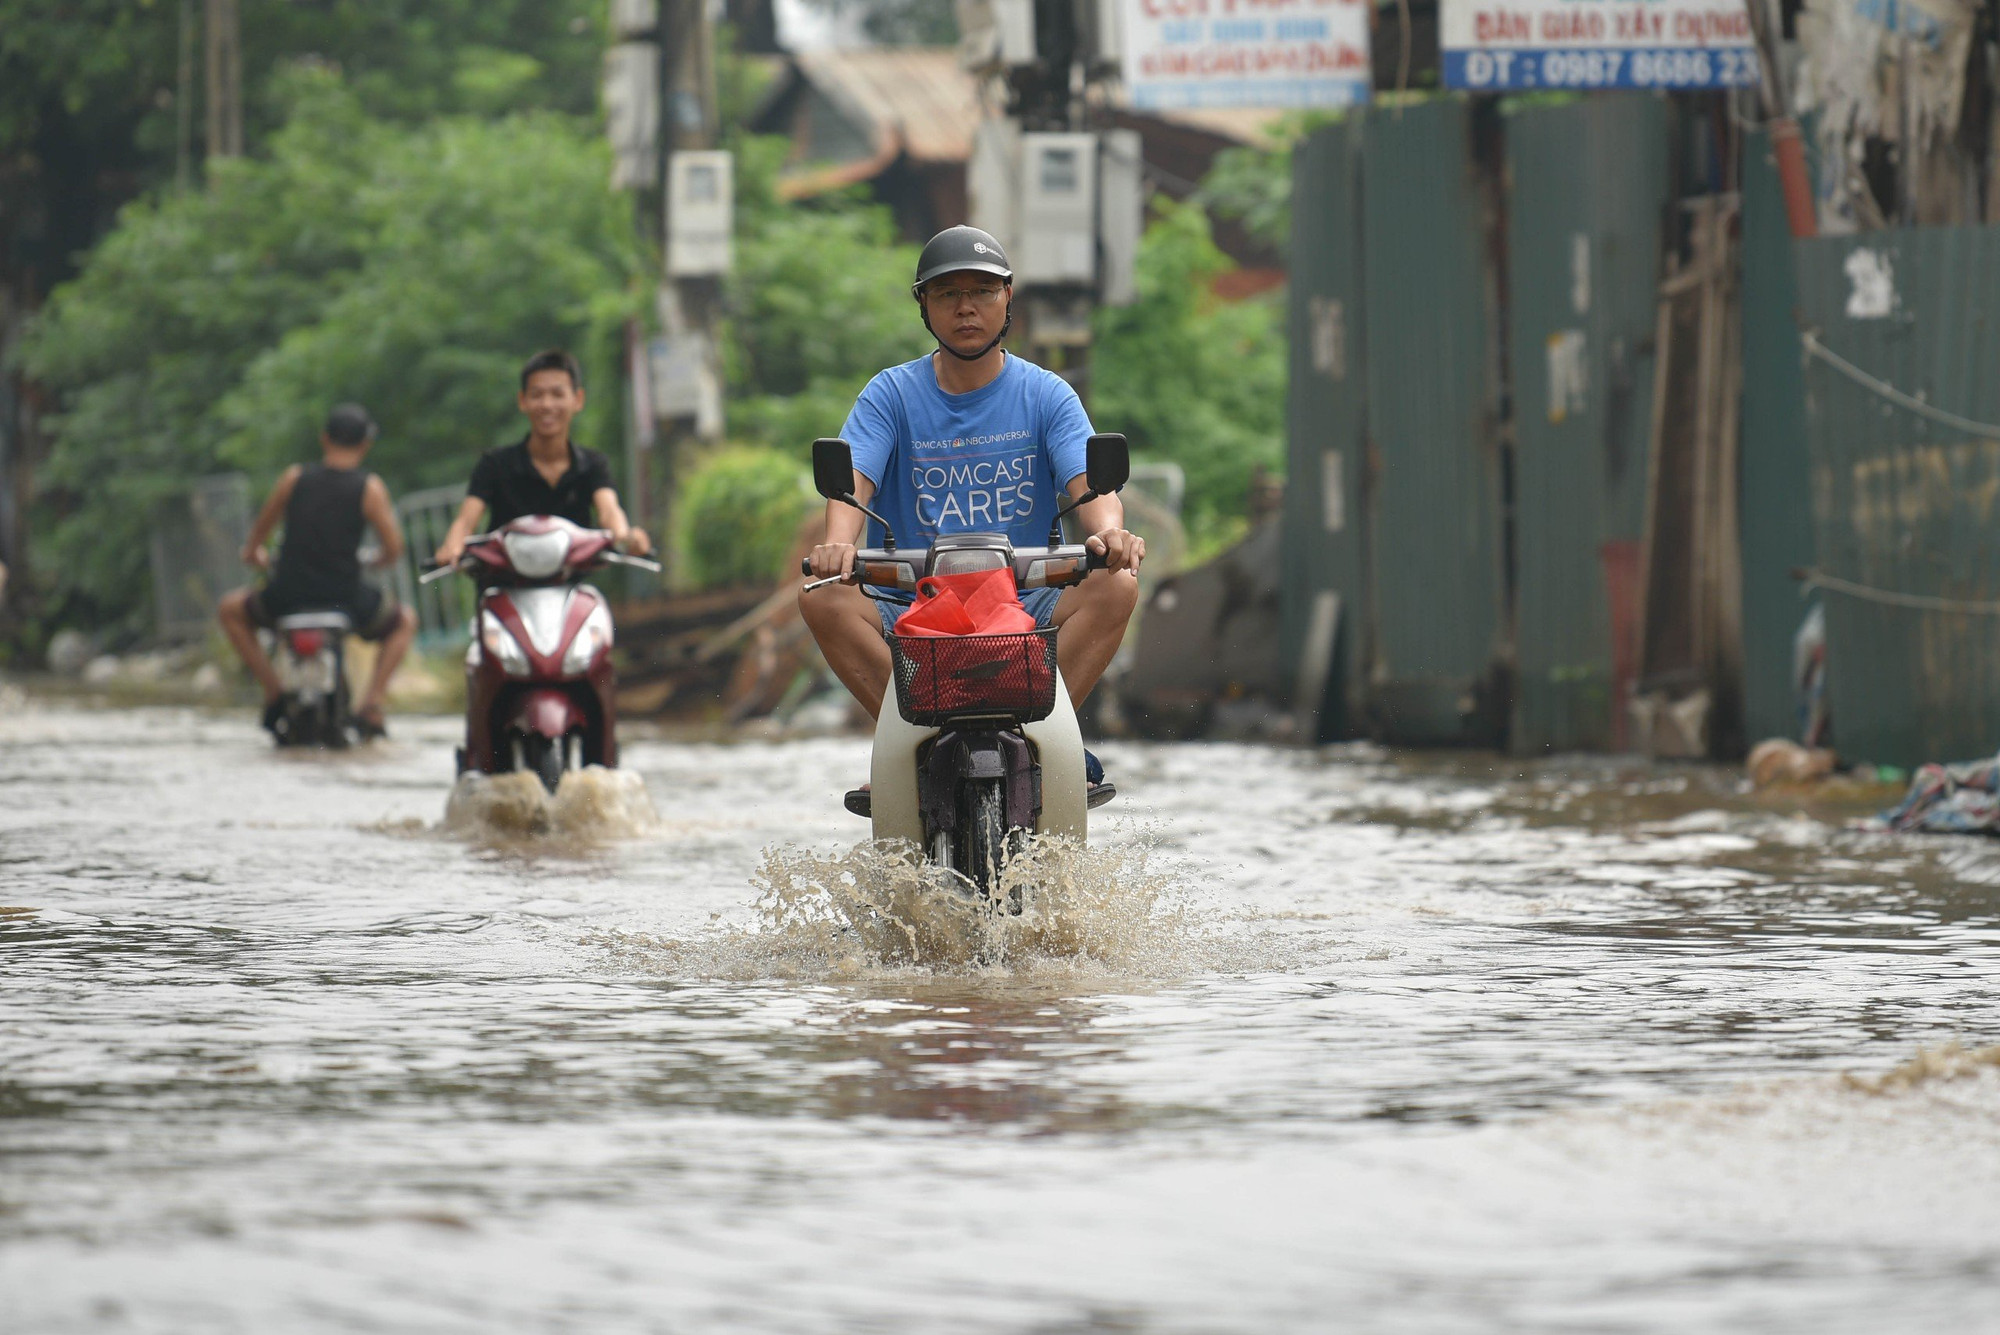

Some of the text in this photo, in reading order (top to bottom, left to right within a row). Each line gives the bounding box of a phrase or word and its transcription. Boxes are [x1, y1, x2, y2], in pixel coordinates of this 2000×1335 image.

[1542, 51, 1622, 87] 0987
[911, 430, 1032, 450] COMCAST NBCUNIVERSAL
[911, 454, 1037, 490] COMCAST
[915, 481, 1035, 528] CARES
